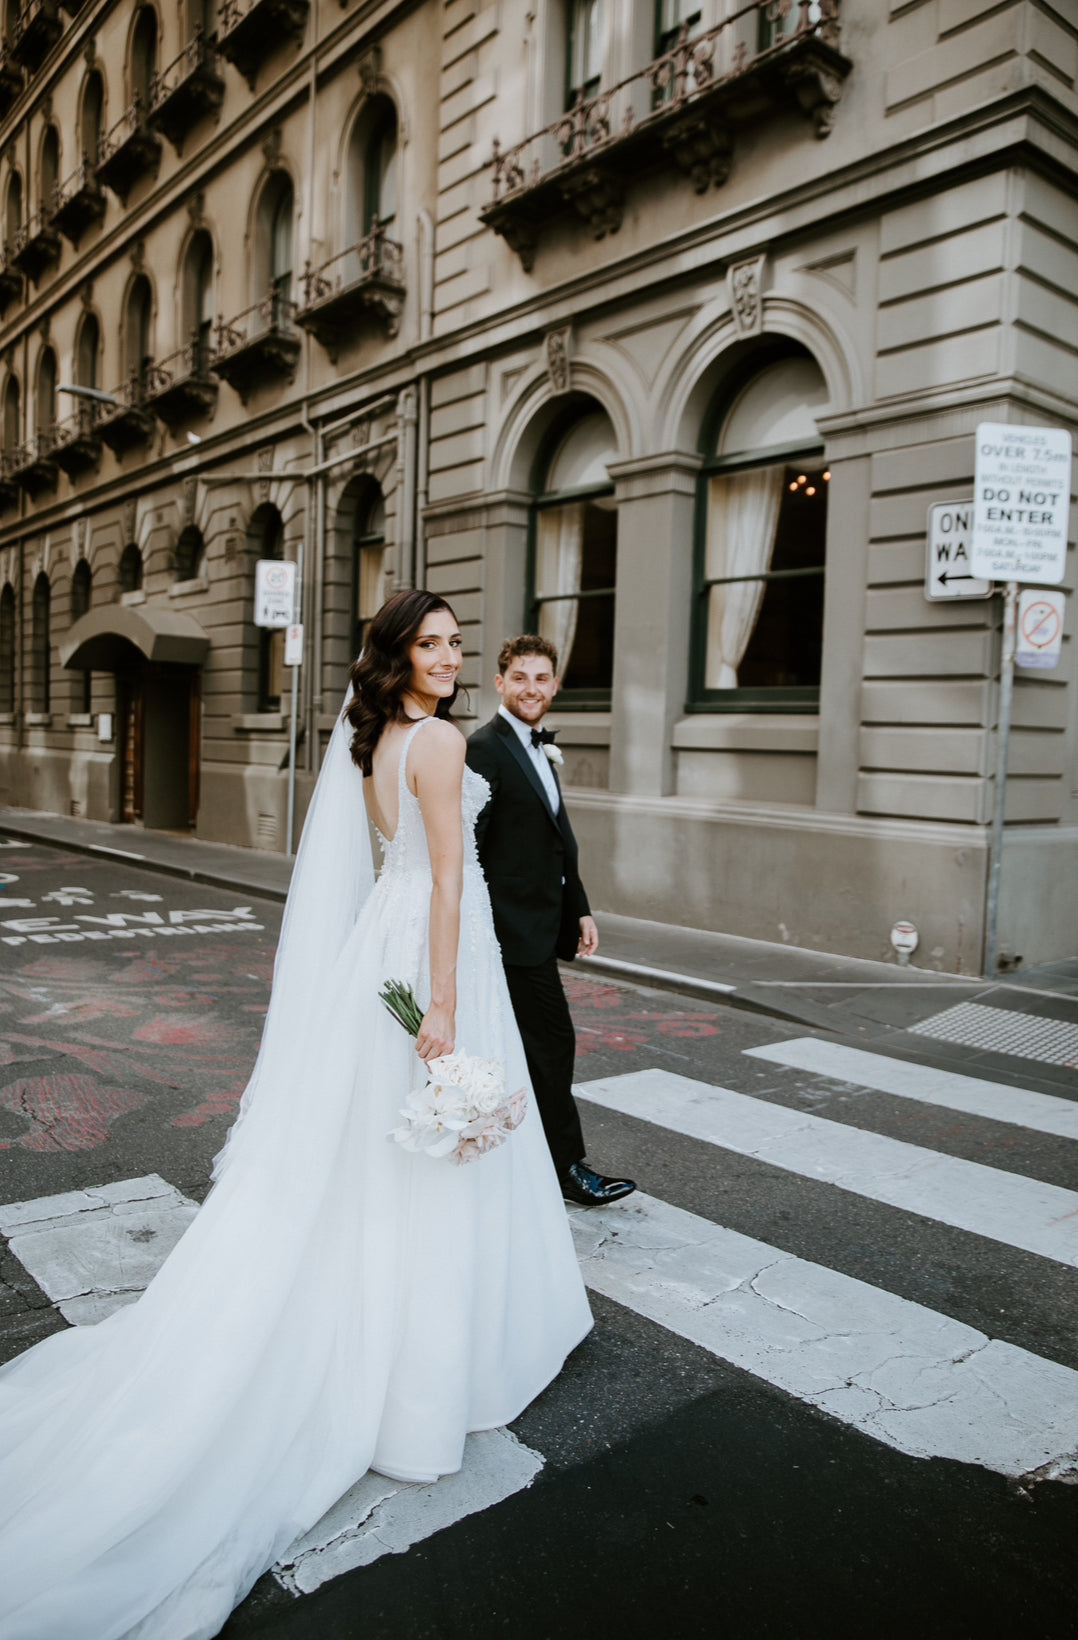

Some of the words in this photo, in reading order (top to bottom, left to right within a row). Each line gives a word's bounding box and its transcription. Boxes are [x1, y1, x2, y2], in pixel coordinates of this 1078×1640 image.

[981, 443, 1025, 459] OVER
[983, 487, 1010, 503] DO
[1019, 489, 1060, 507] NOT
[941, 511, 975, 533] ON
[986, 506, 1054, 525] ENTER
[936, 542, 968, 562] WA
[1, 922, 265, 946] PEDESTRIANS
